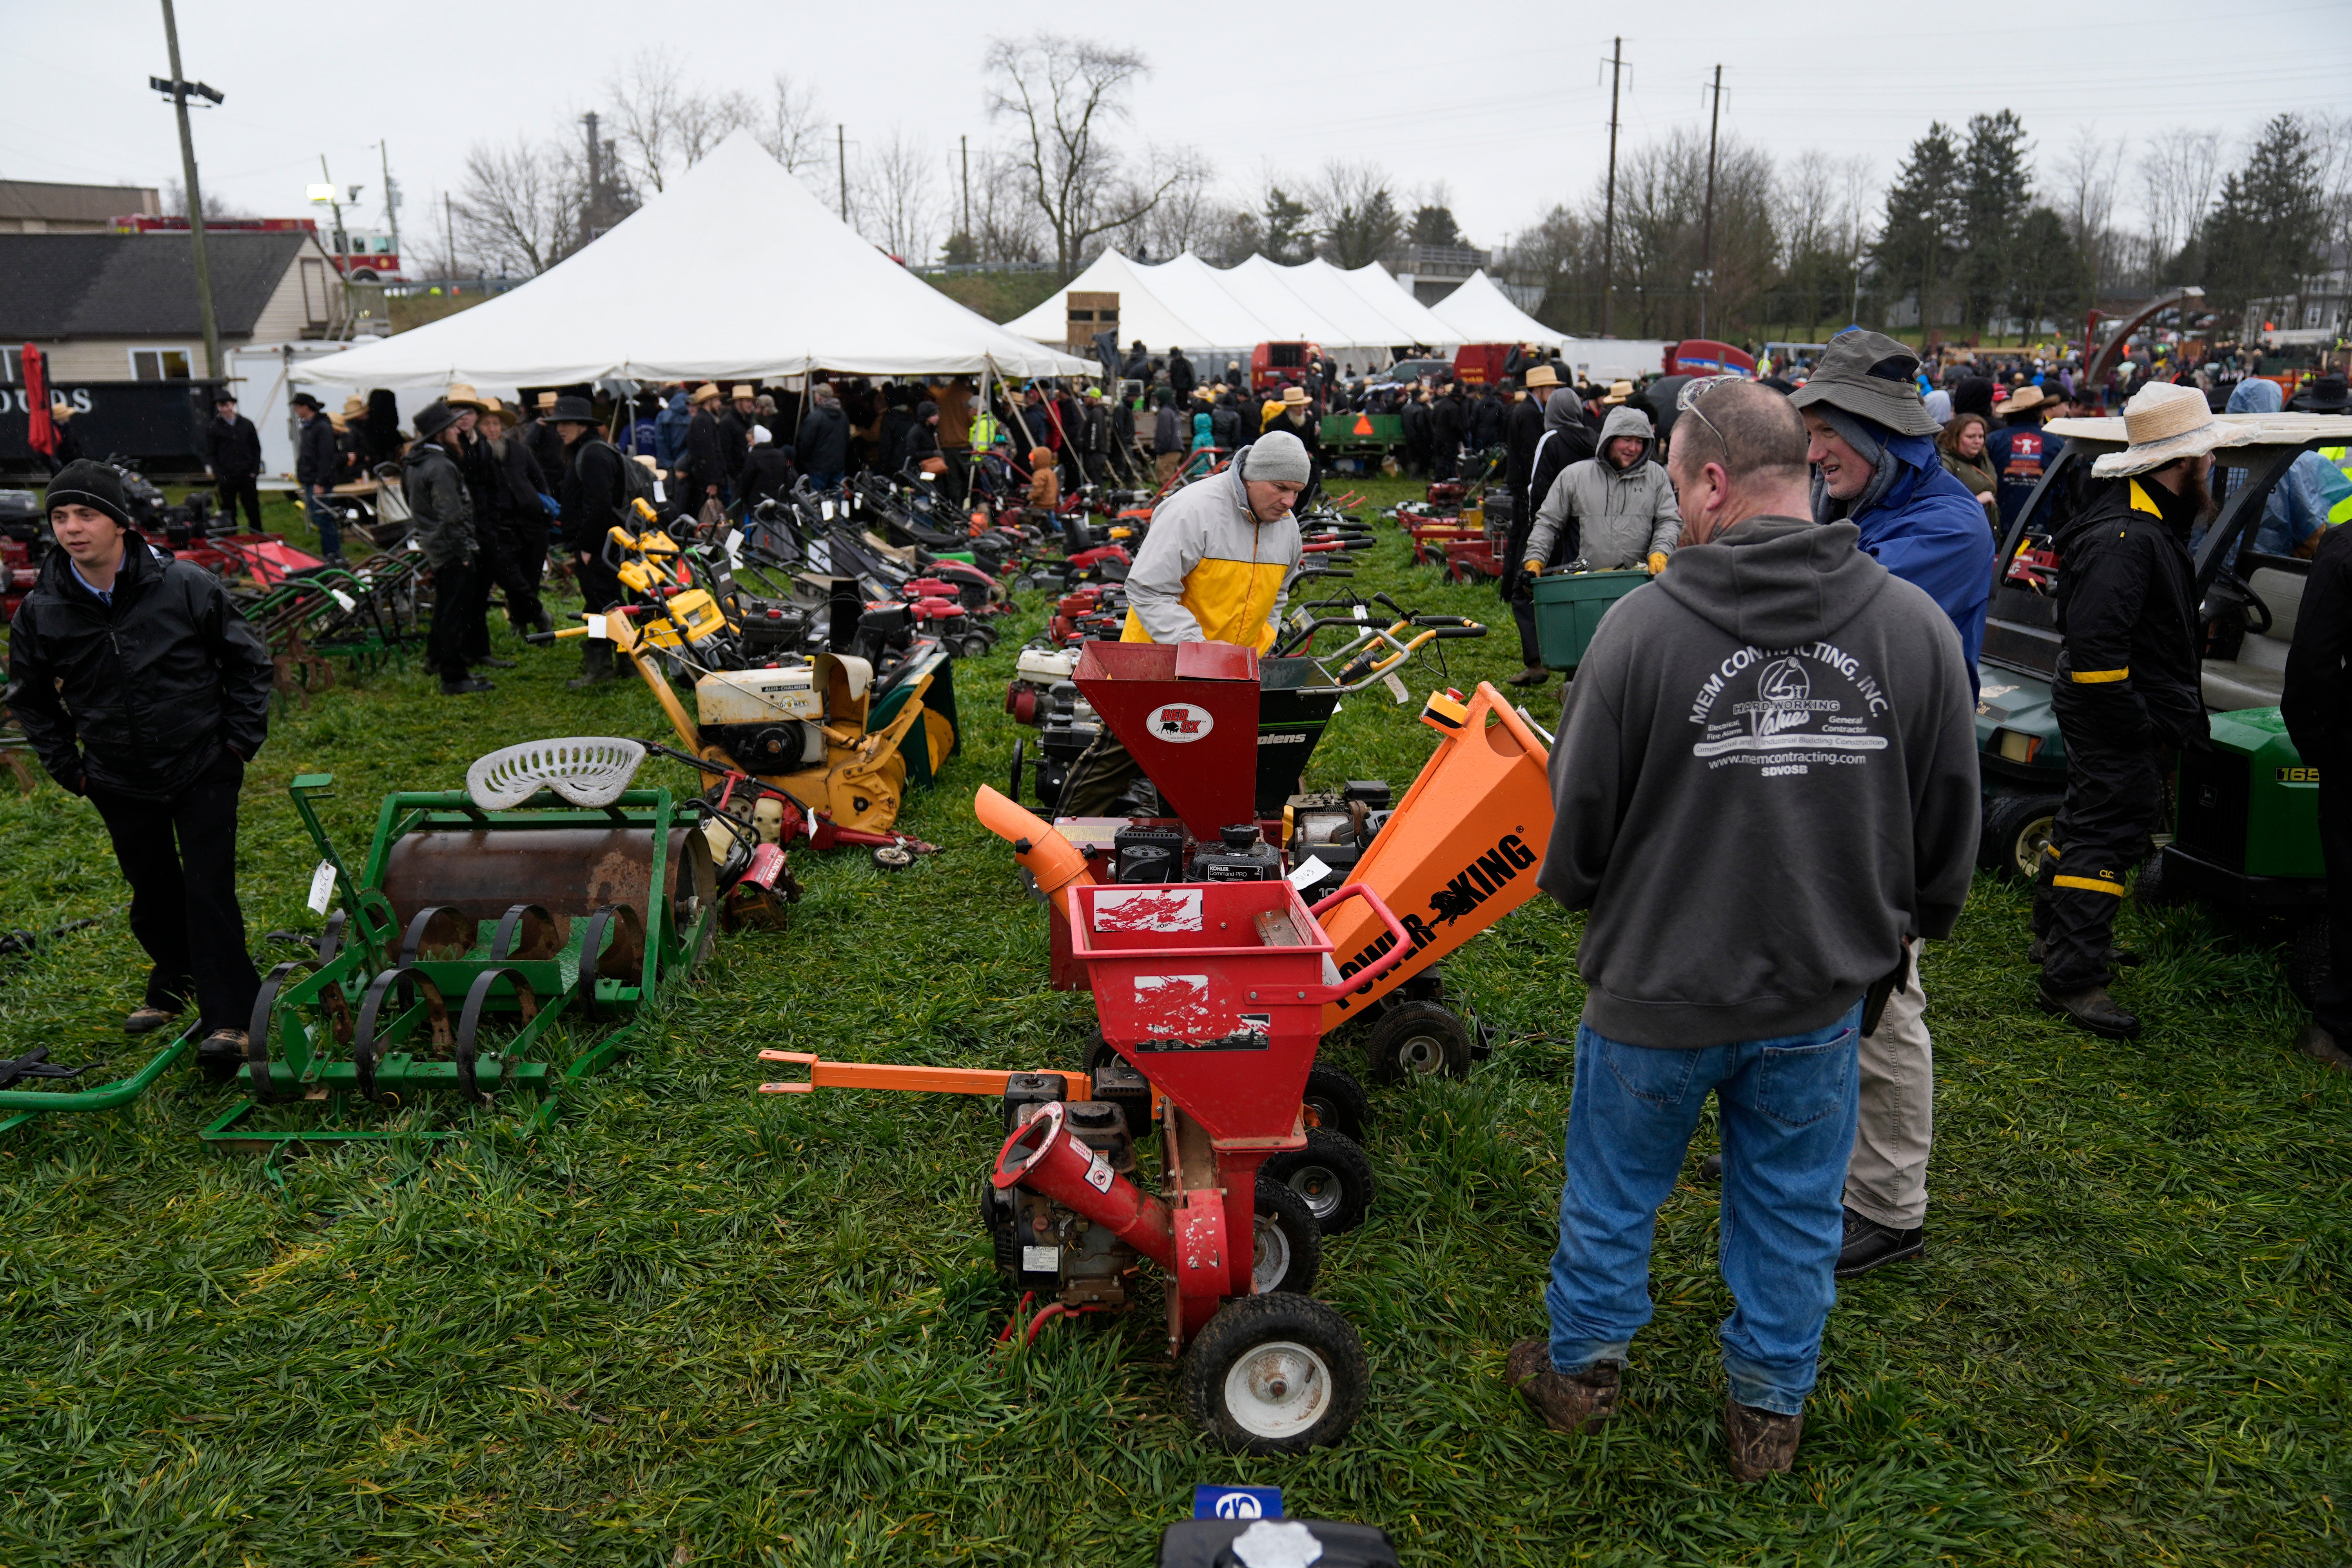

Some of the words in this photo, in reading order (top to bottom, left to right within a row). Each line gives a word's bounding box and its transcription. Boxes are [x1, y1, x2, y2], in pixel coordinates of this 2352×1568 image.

[1689, 673, 1725, 724] MEM
[1857, 675, 1888, 717] INC.
[1160, 709, 1189, 721] RED
[1828, 715, 1863, 724] General
[1180, 720, 1201, 733] OX
[1708, 719, 1742, 731] Electrical,
[1749, 708, 1810, 748] Values
[1822, 724, 1868, 733] Contractor
[1257, 734, 1307, 745] olens
[1721, 728, 1743, 738] Alarm
[1696, 740, 1737, 753] Commercial
[1762, 737, 1797, 745] Industrial
[1798, 736, 1834, 746] Building
[1835, 737, 1884, 746] Construction
[1708, 751, 1866, 769] www.memcontracting.com
[1761, 764, 1809, 777] SDVOSB
[766, 855, 785, 883] HONDA
[1296, 869, 1314, 881] 3163
[1447, 834, 1537, 904] KING
[2100, 869, 2114, 879] CLC
[318, 870, 329, 904] 2564
